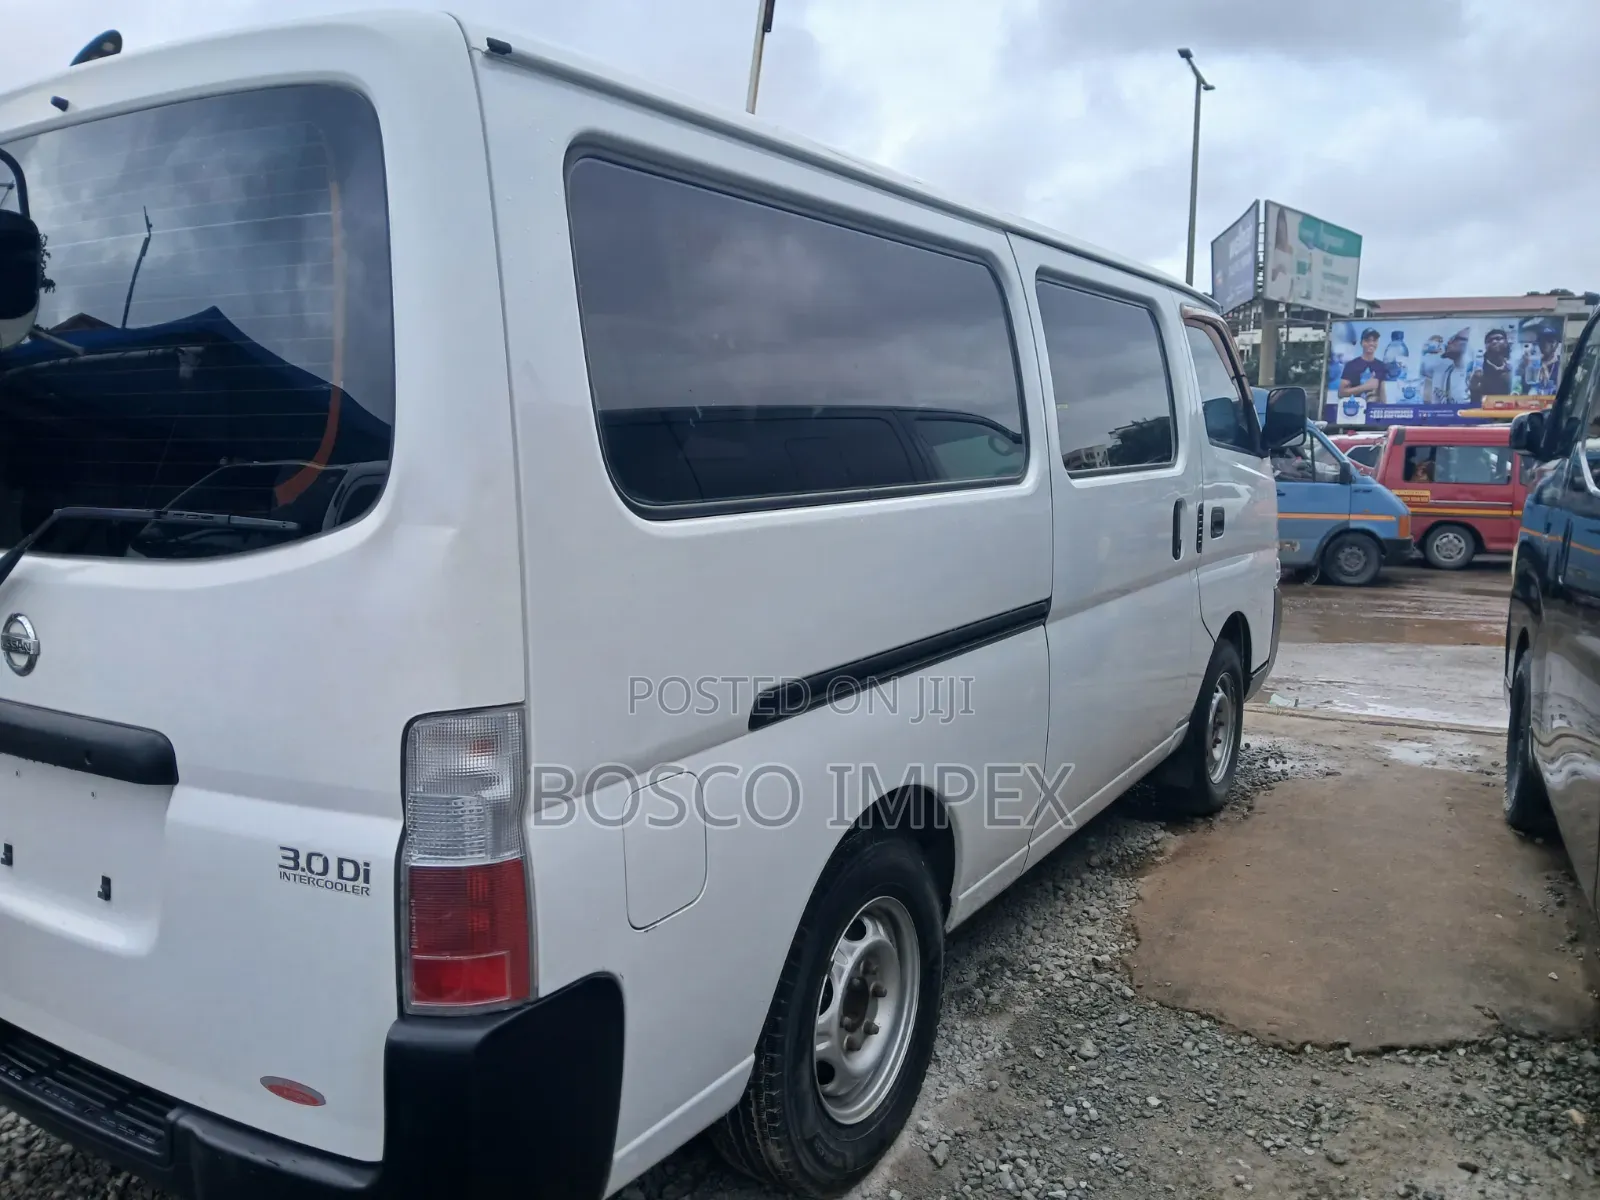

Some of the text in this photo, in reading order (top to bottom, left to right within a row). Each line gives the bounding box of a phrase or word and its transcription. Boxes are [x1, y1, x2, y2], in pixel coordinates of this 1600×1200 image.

[278, 846, 370, 884] 3.0 Di
[279, 871, 370, 897] INTERCOOLER
